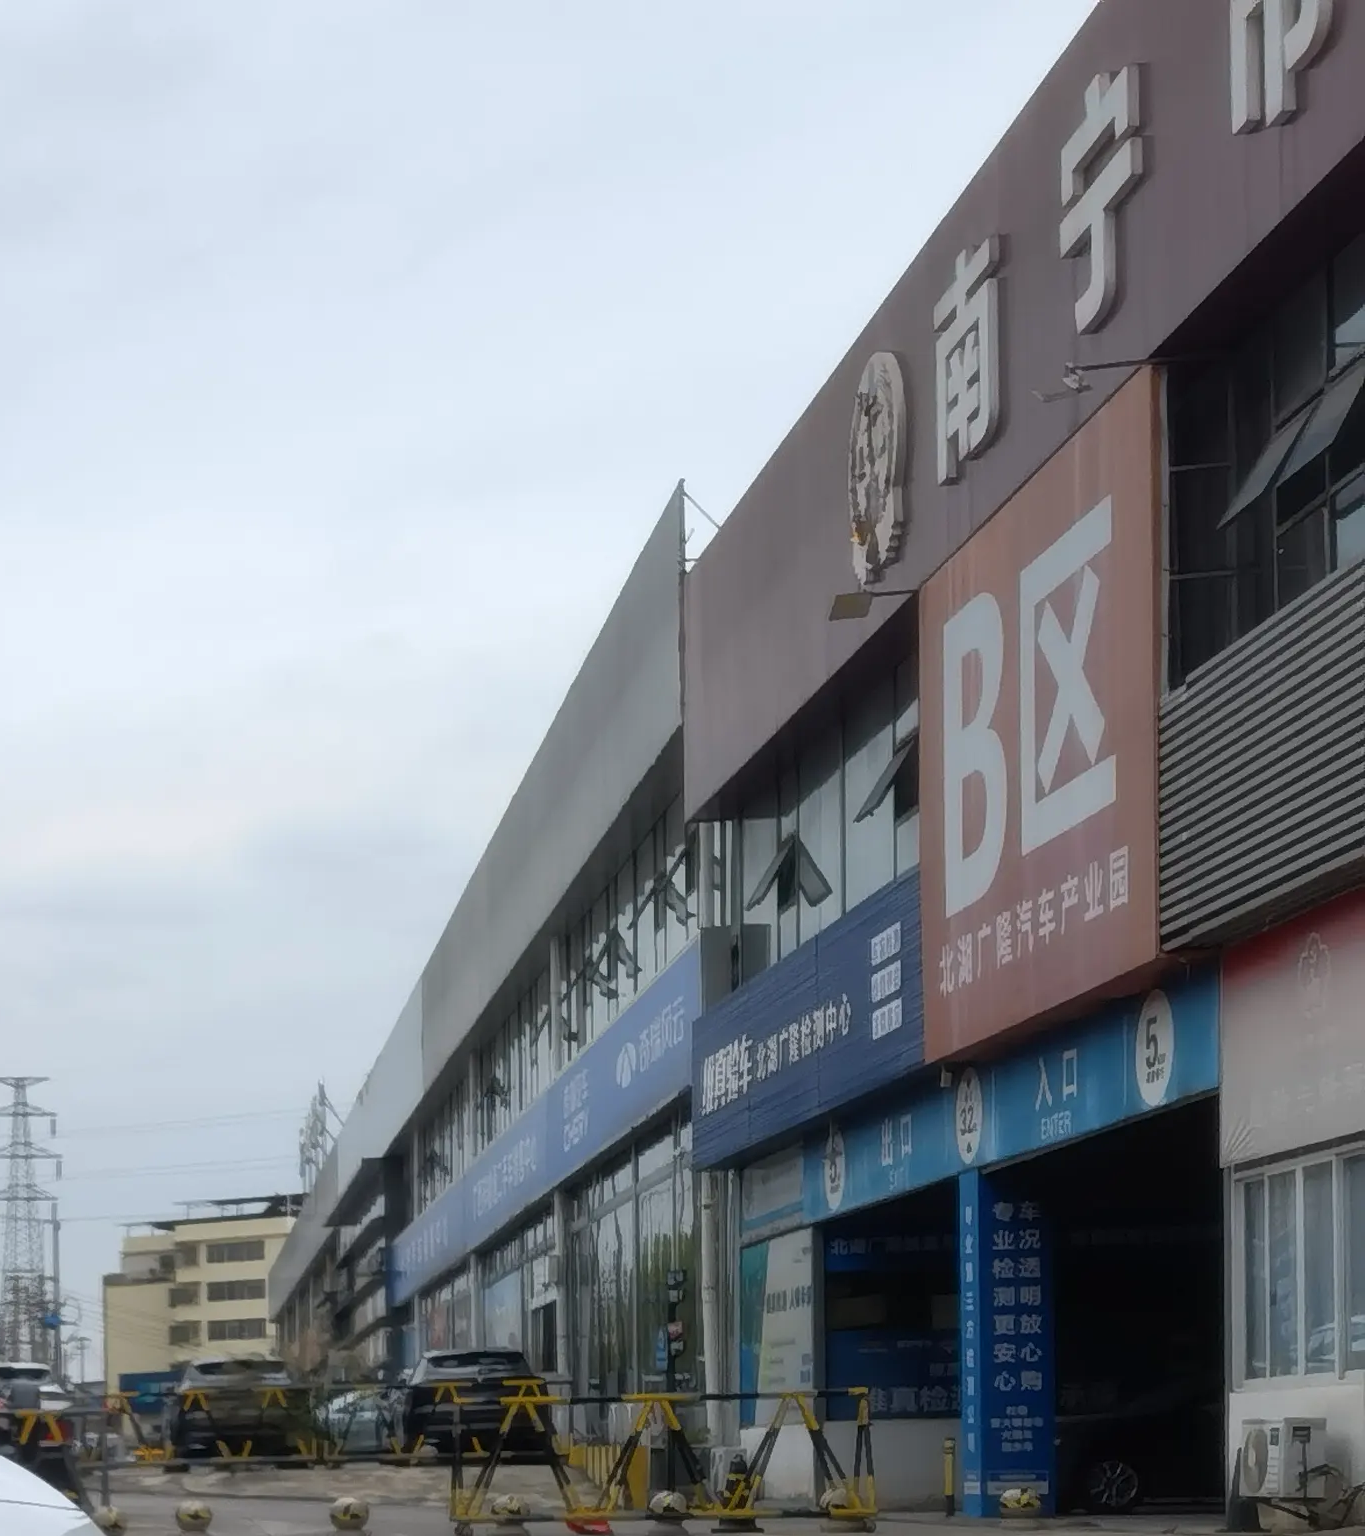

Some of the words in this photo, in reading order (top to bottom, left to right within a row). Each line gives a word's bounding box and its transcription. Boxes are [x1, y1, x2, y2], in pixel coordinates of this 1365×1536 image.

[943, 495, 1117, 918] B区
[939, 845, 1130, 998] 北湖广隆汽车产业园
[1035, 1048, 1077, 1112] 入口
[881, 1114, 912, 1167] 出口
